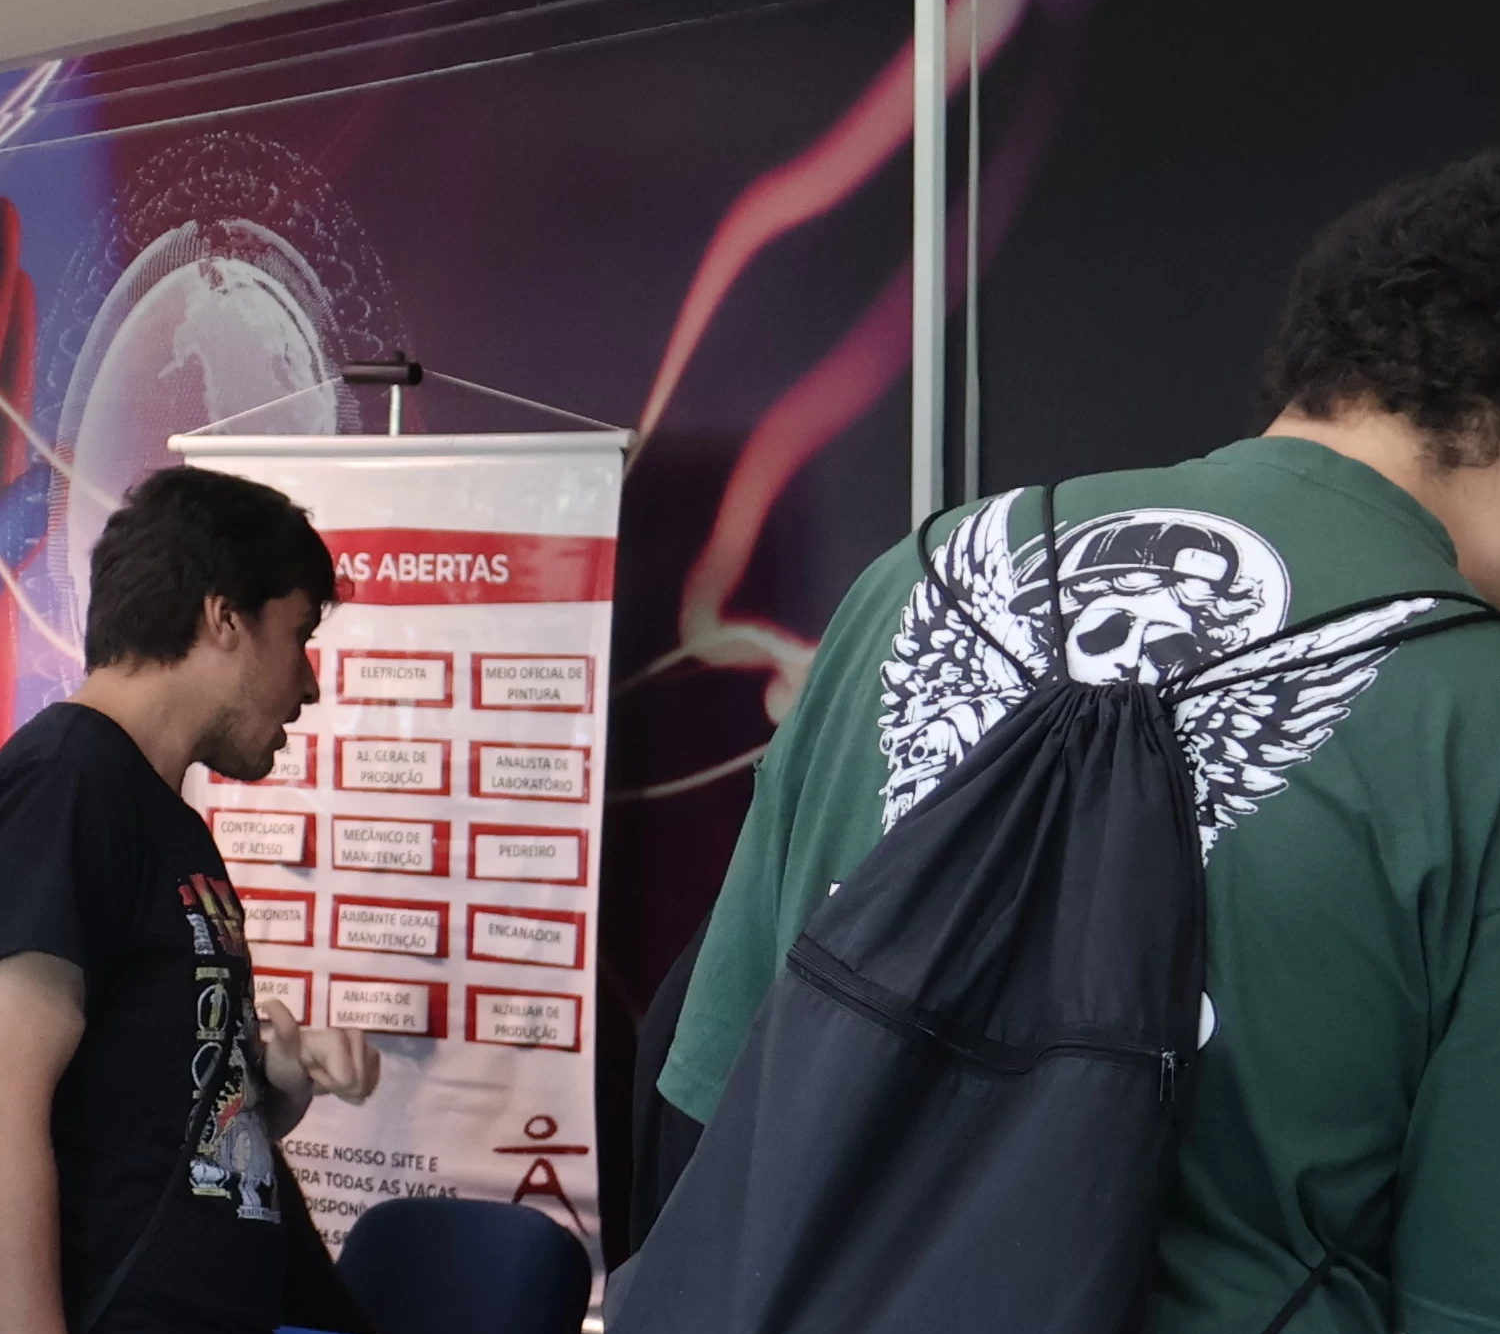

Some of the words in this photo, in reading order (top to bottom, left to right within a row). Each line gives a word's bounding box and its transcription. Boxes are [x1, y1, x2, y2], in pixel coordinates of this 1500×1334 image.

[376, 553, 509, 584] ABERTAS
[360, 666, 427, 680] ELETRICISTA
[485, 666, 517, 679] MEIO
[519, 666, 565, 680] OFICIAL
[568, 667, 583, 680] DE
[507, 688, 561, 702] PINTURA
[375, 750, 410, 763] GERAL
[413, 751, 428, 764] DE
[496, 755, 551, 770] ANALISTA
[554, 758, 568, 770] DE
[360, 769, 424, 786] PRODUÇÃO
[491, 776, 573, 793] LABORATÓRIO
[221, 821, 295, 836] CONTROLADOR
[343, 827, 404, 843] MECÂNICO
[406, 831, 421, 844] DE
[232, 841, 246, 854] DE
[249, 842, 283, 855] ACESSO
[499, 844, 557, 858] PEDREIRO
[341, 849, 422, 867] MANUTENÇÃO
[340, 910, 397, 927] AJUDANTE
[348, 931, 427, 949] MANUTENÇÃO
[488, 922, 562, 943] ENCANADOR
[343, 989, 391, 1004] ANALISTA
[395, 992, 411, 1005] DE
[336, 1011, 398, 1026] MARKETING
[546, 1005, 560, 1018] DE
[494, 1023, 557, 1042] PRODUÇÃO
[333, 1146, 385, 1166] NOSSO
[391, 1151, 423, 1171] SITE
[428, 1156, 439, 1172] E
[326, 1171, 374, 1193] TODAS
[378, 1178, 401, 1197] AS
